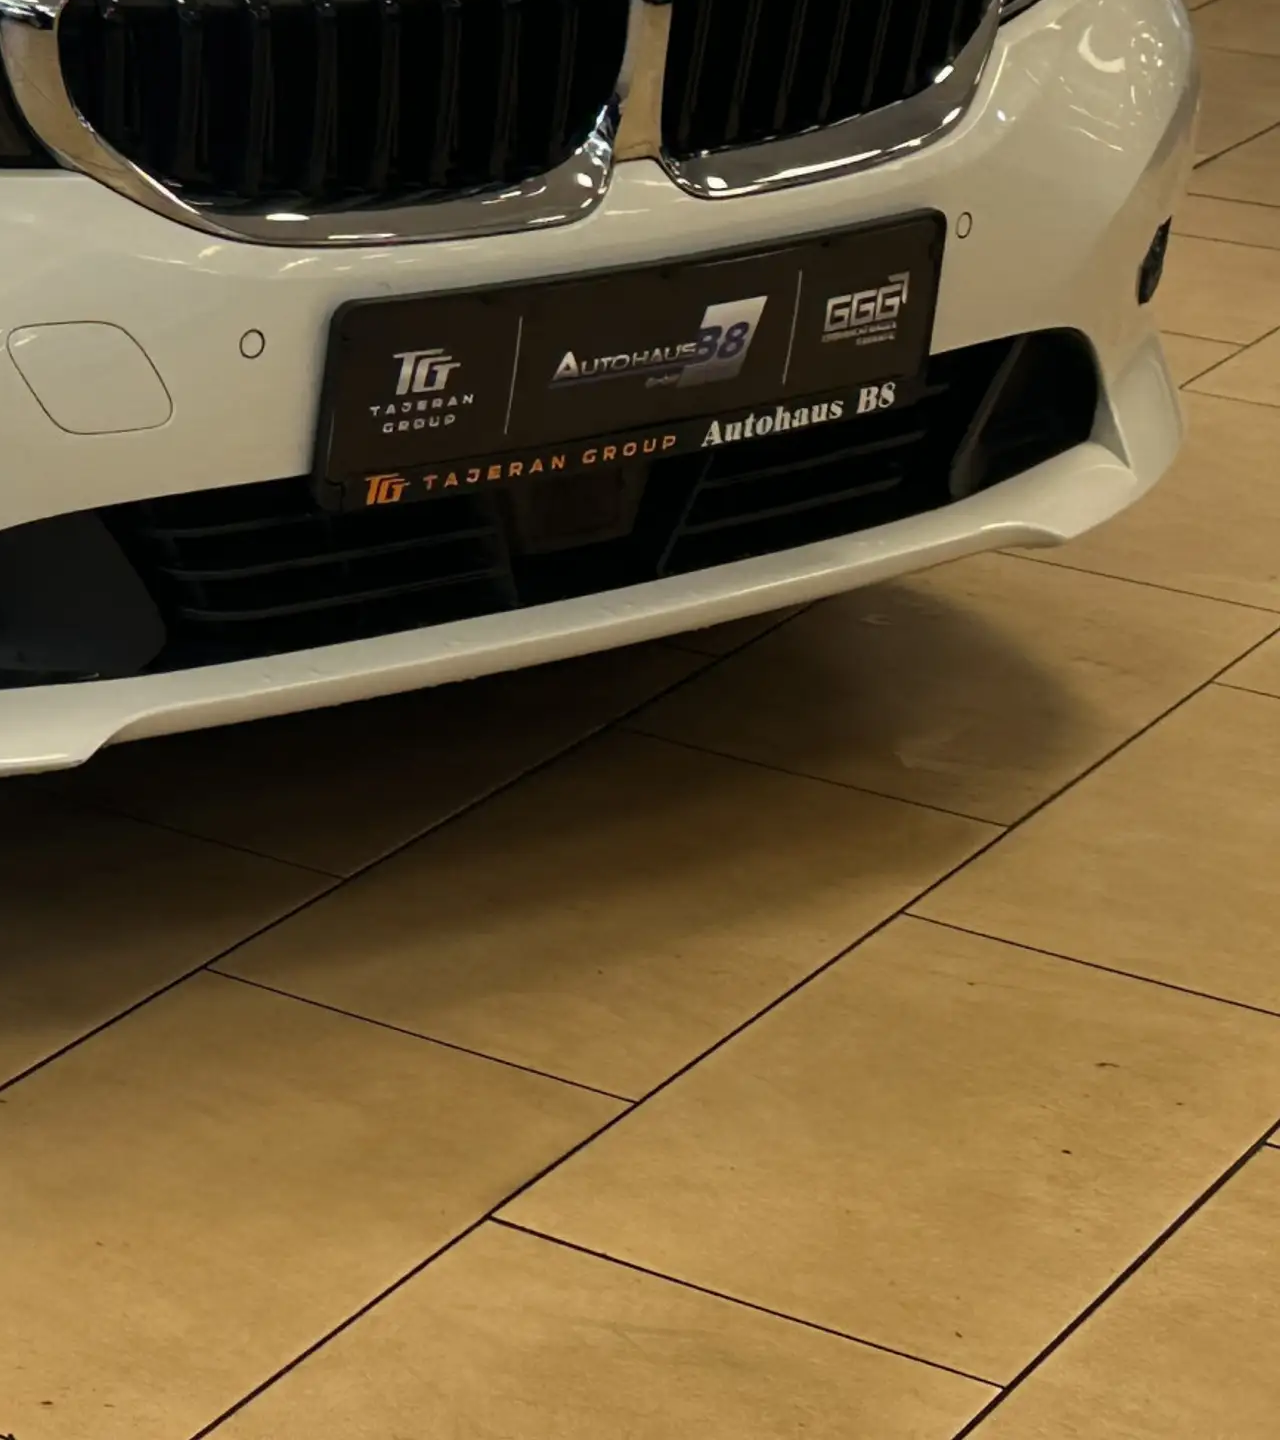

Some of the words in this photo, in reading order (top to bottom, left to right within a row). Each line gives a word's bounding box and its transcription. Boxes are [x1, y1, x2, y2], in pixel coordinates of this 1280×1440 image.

[369, 394, 474, 417] TAJERAN
[382, 414, 456, 434] GROUP
[423, 455, 566, 490] TAJERAN
[582, 435, 676, 464] GROUP
[701, 399, 844, 447] Autohaus
[856, 381, 897, 414] B8
